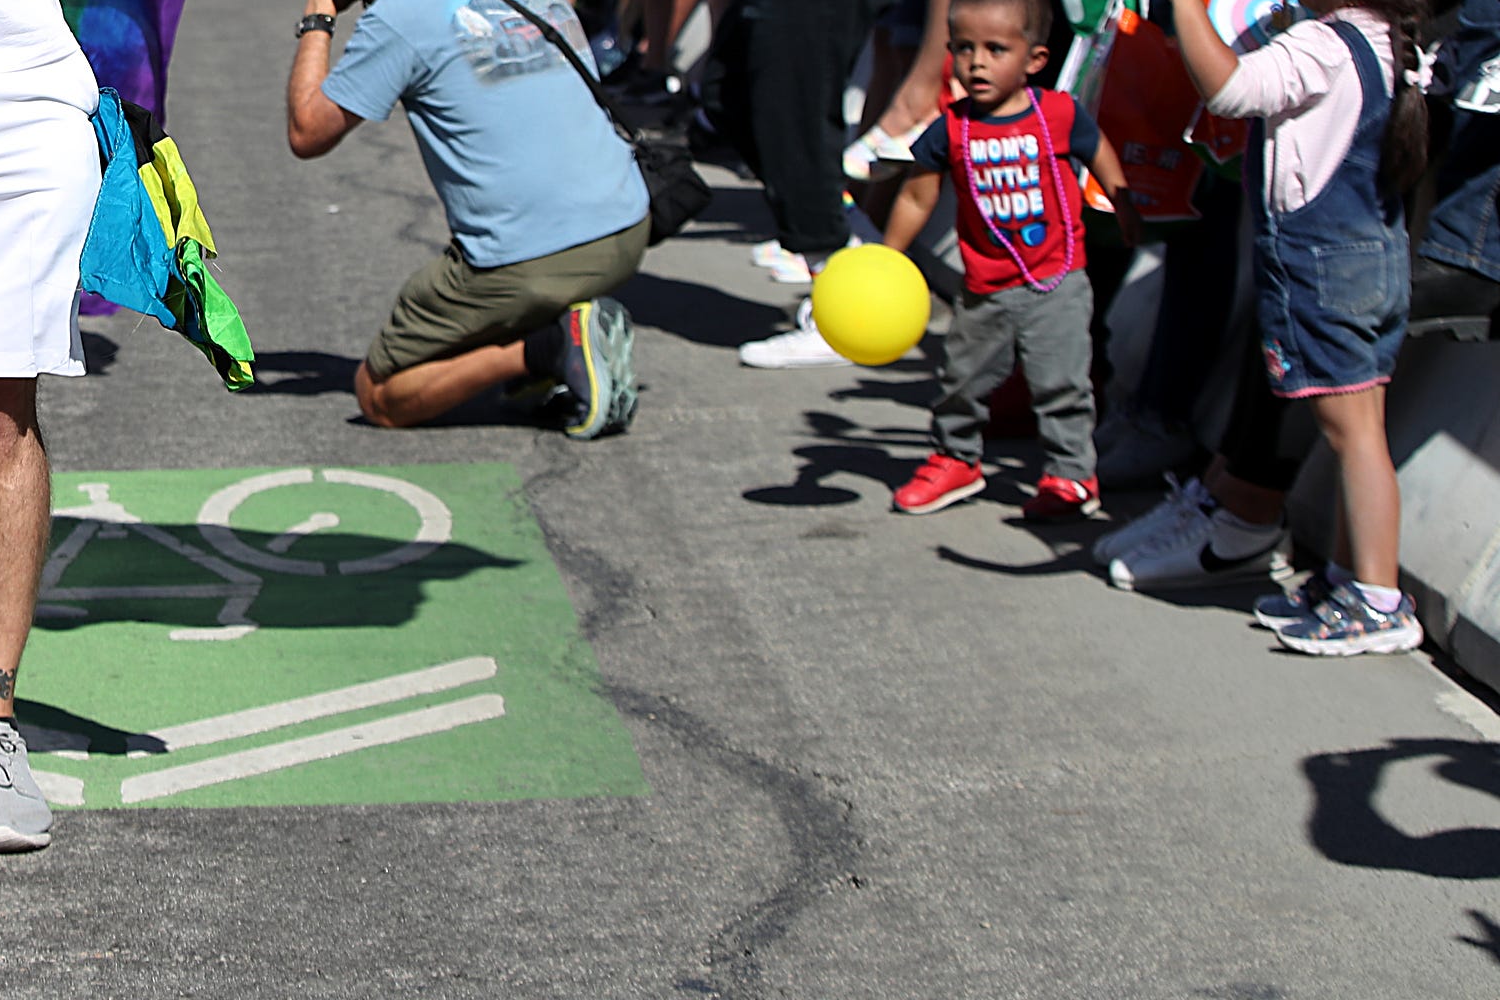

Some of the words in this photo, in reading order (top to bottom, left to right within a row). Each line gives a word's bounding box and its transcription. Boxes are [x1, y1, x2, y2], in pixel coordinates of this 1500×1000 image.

[969, 133, 1039, 164] MOM'S
[974, 163, 1040, 191] LITTLE
[978, 187, 1044, 223] DUDE
